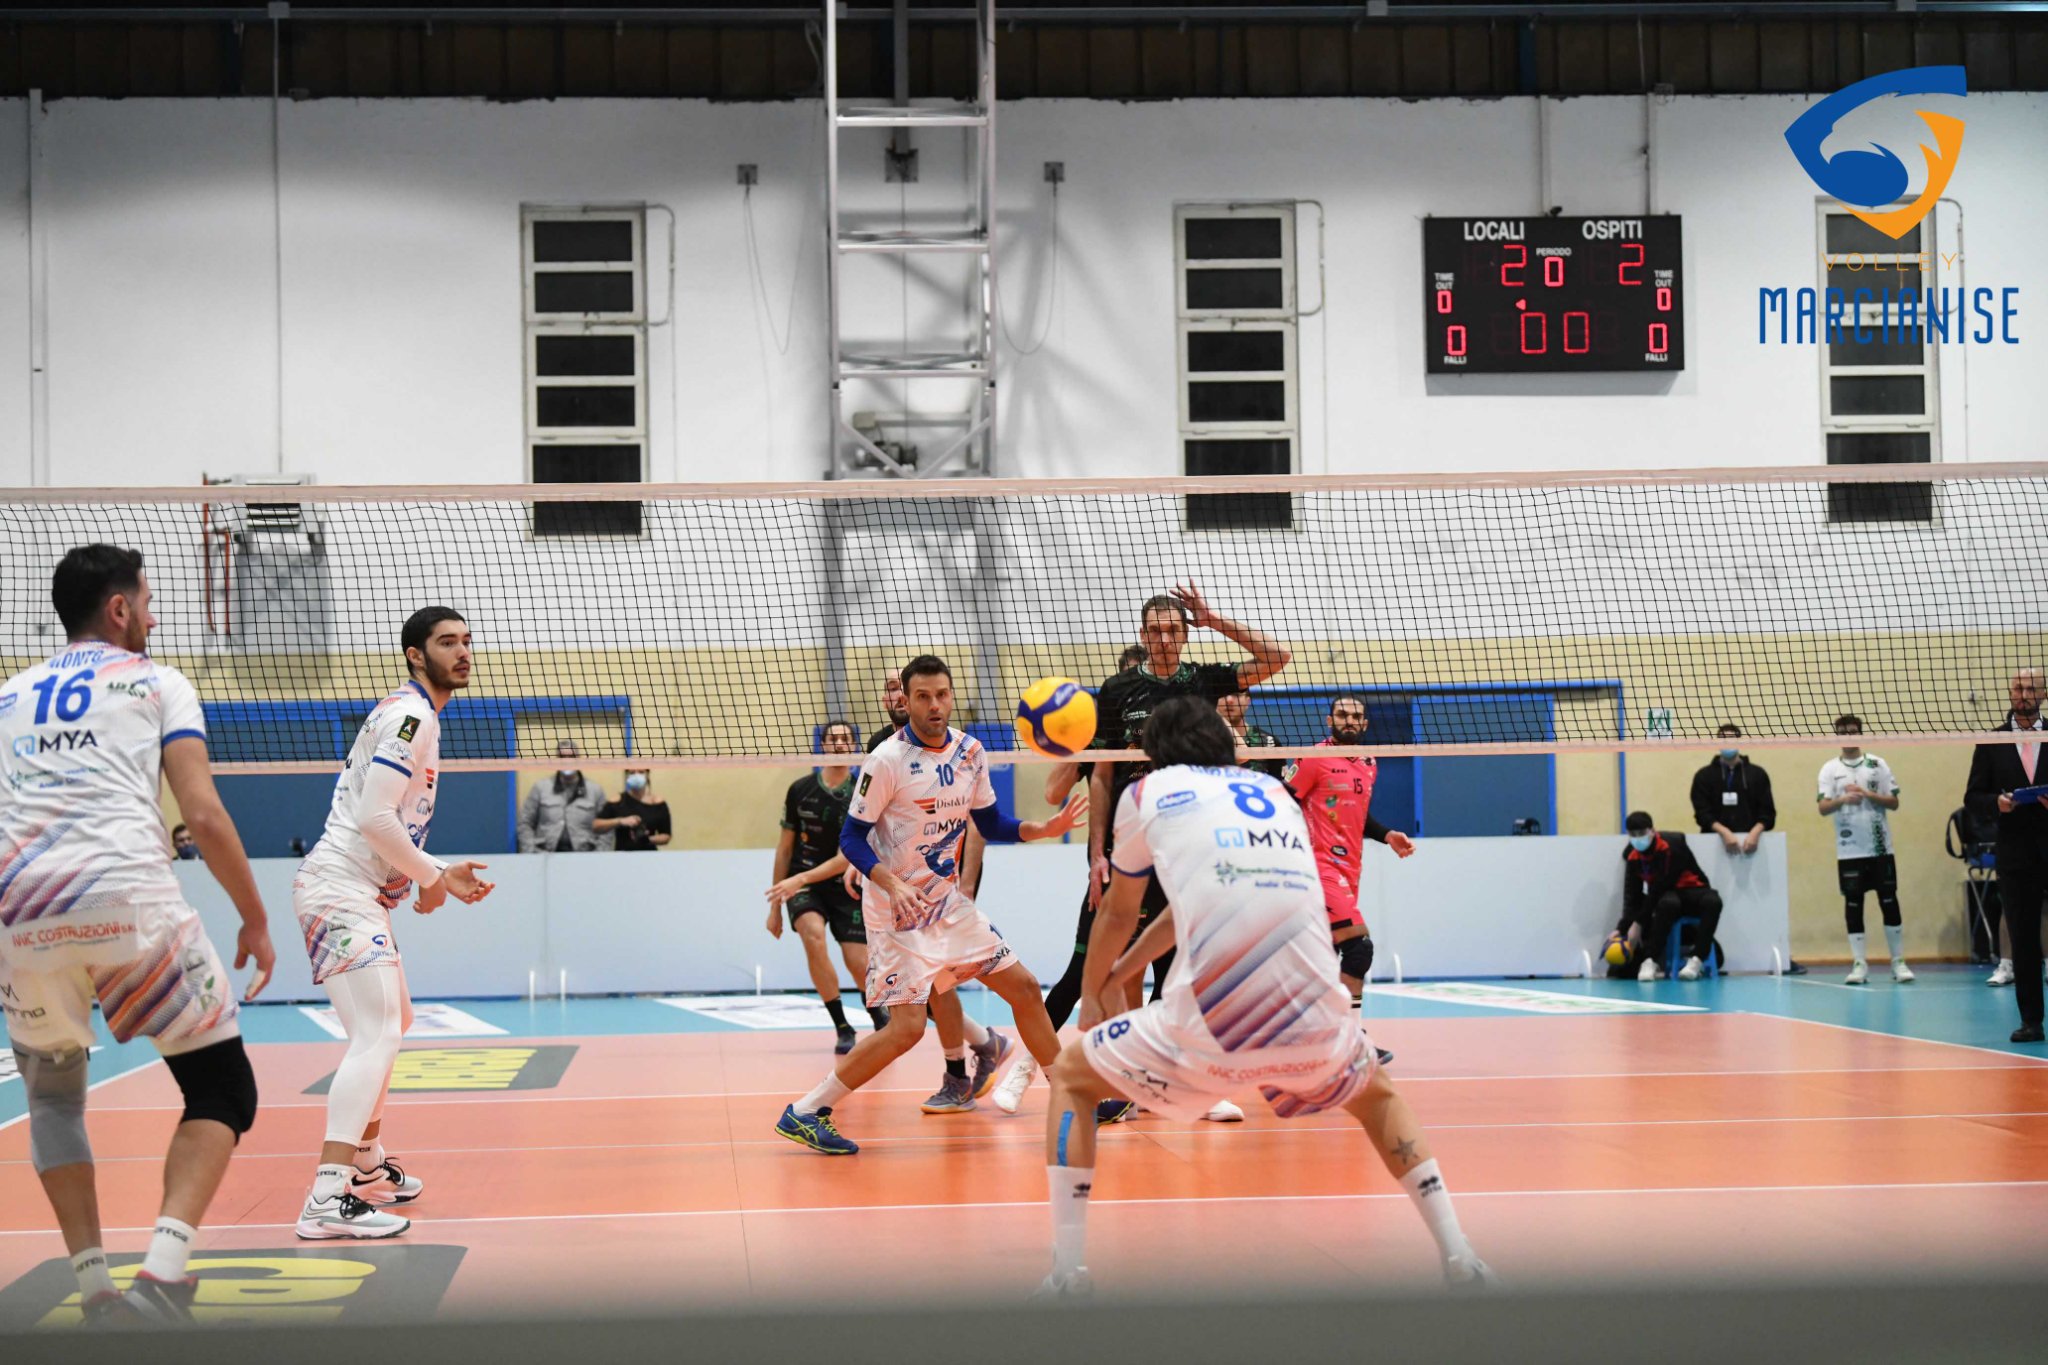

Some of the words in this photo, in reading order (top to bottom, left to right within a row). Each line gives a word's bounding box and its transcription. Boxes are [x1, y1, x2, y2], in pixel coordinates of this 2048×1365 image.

[1464, 221, 1525, 241] LOCALI
[1582, 220, 1643, 240] OSPITI
[1536, 247, 1572, 257] PERIODO
[1501, 244, 1527, 287] 2
[1544, 256, 1564, 287] 0
[1618, 243, 1644, 286] 2
[1654, 269, 1674, 279] TIME
[1434, 272, 1454, 282] TIME
[1436, 281, 1453, 290] OUT
[1655, 278, 1672, 288] OUT
[1437, 290, 1452, 314] 0
[1656, 287, 1672, 311] 0
[1447, 325, 1466, 356] 0
[1649, 323, 1668, 353] 0
[1443, 356, 1467, 365] FALLI
[1645, 353, 1668, 362] FALLI
[32, 669, 95, 725] 16
[39, 729, 98, 753] MYA
[936, 763, 954, 787] 10
[1353, 778, 1363, 794] 15
[1228, 783, 1276, 819] 8
[938, 818, 965, 834] MYA
[1247, 828, 1306, 853] MYA
[1108, 1020, 1130, 1039] 8
